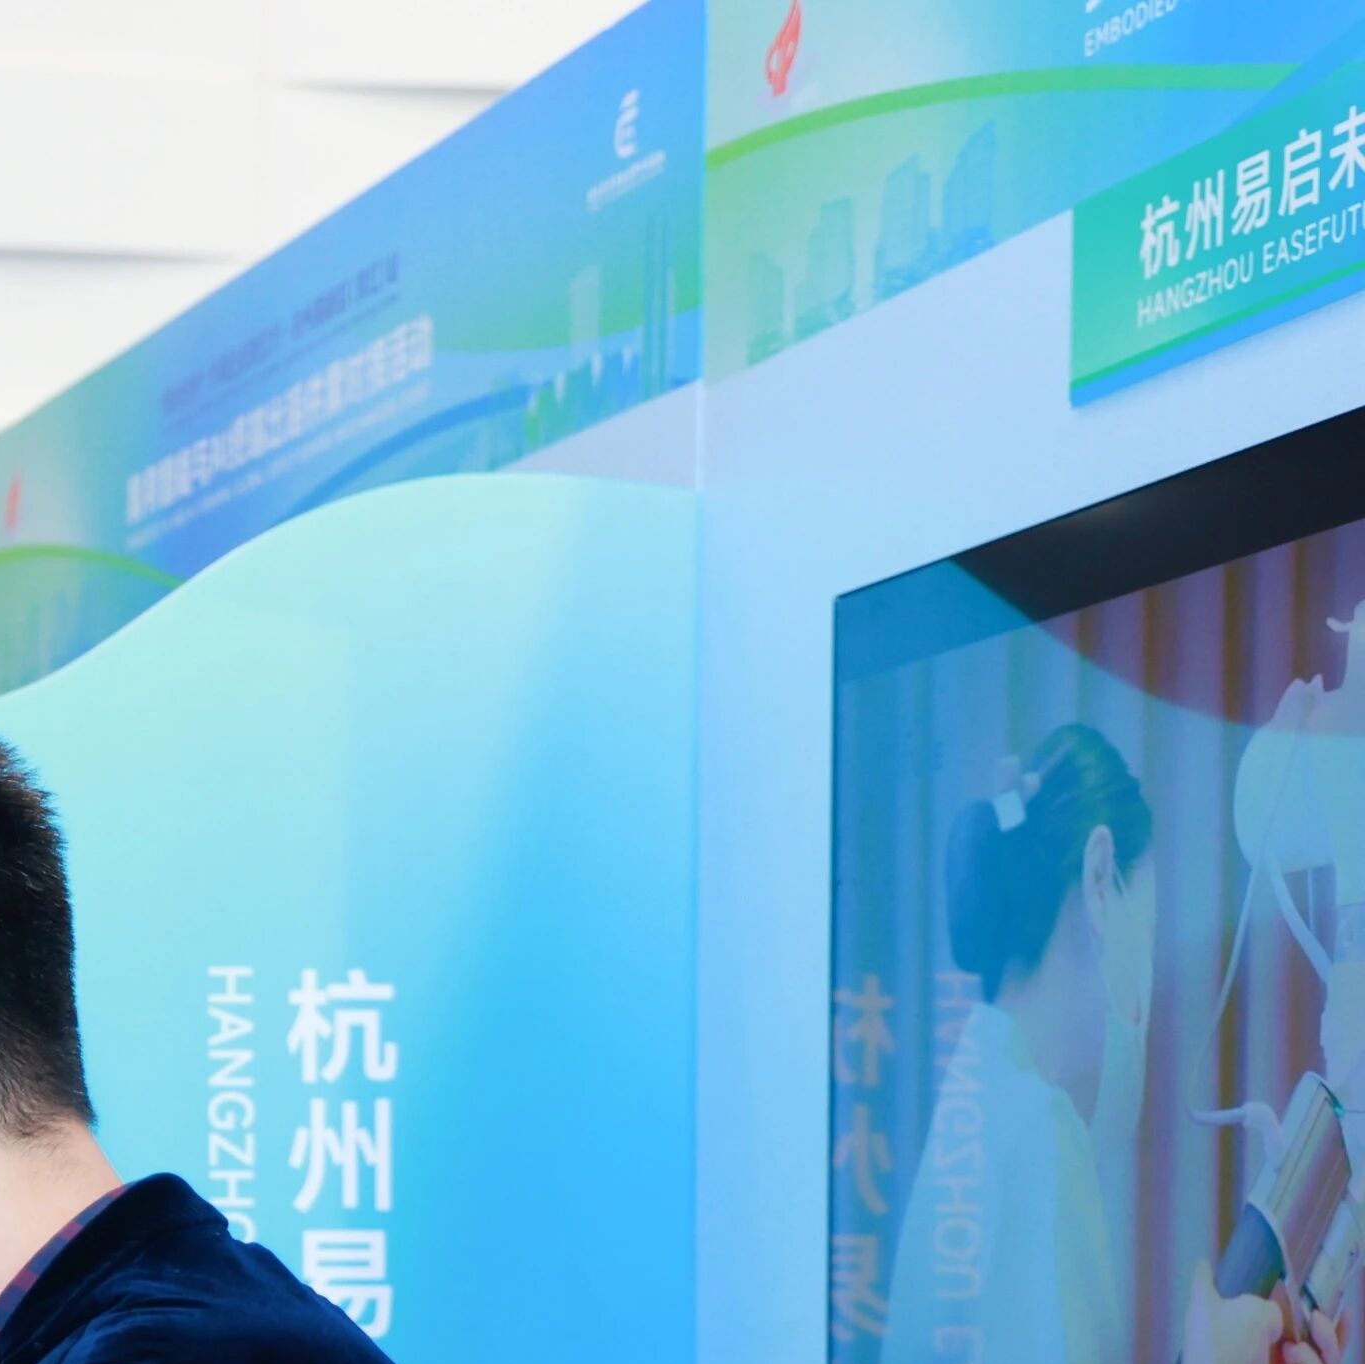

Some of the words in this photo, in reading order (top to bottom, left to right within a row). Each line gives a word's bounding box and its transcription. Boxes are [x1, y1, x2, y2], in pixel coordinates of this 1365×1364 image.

[1138, 104, 1365, 280] 杭州易启未
[1136, 250, 1255, 328] HANGZHOU
[287, 968, 399, 1338] 杭州易
